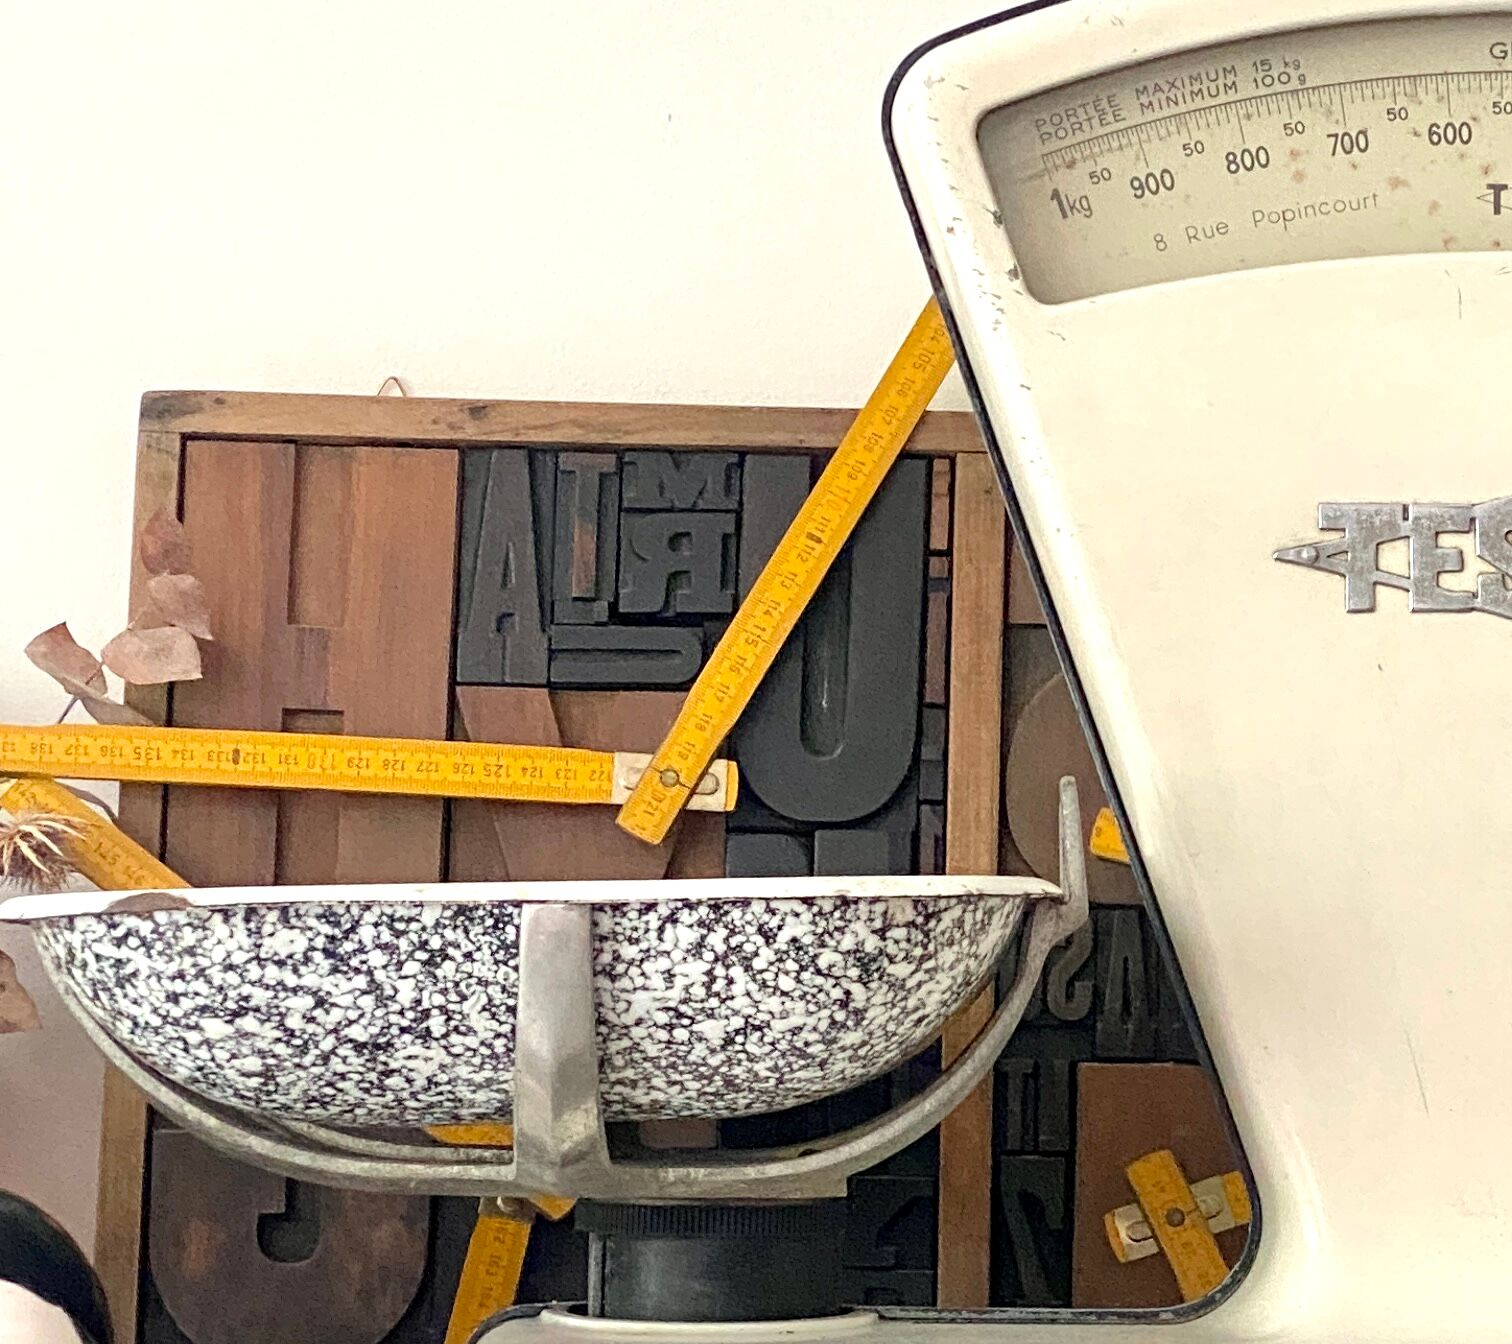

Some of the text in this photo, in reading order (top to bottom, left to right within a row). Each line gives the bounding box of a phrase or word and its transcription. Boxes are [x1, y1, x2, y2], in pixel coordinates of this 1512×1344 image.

[1035, 58, 1301, 133] PORTÉE MAXIMUM 15 kg
[1039, 108, 1126, 146] PORTÉE
[1139, 81, 1238, 116] MINIMUM
[1253, 71, 1291, 89] 100
[1089, 167, 1112, 185] 50
[1182, 140, 1205, 157] 50
[1283, 120, 1305, 136] 50
[1386, 104, 1409, 121] 50
[1130, 168, 1175, 199] 900
[1225, 146, 1270, 174] 800
[1326, 130, 1370, 156] 700
[1427, 122, 1473, 146] 600
[1153, 192, 1379, 252] 8 Rue Popincourt
